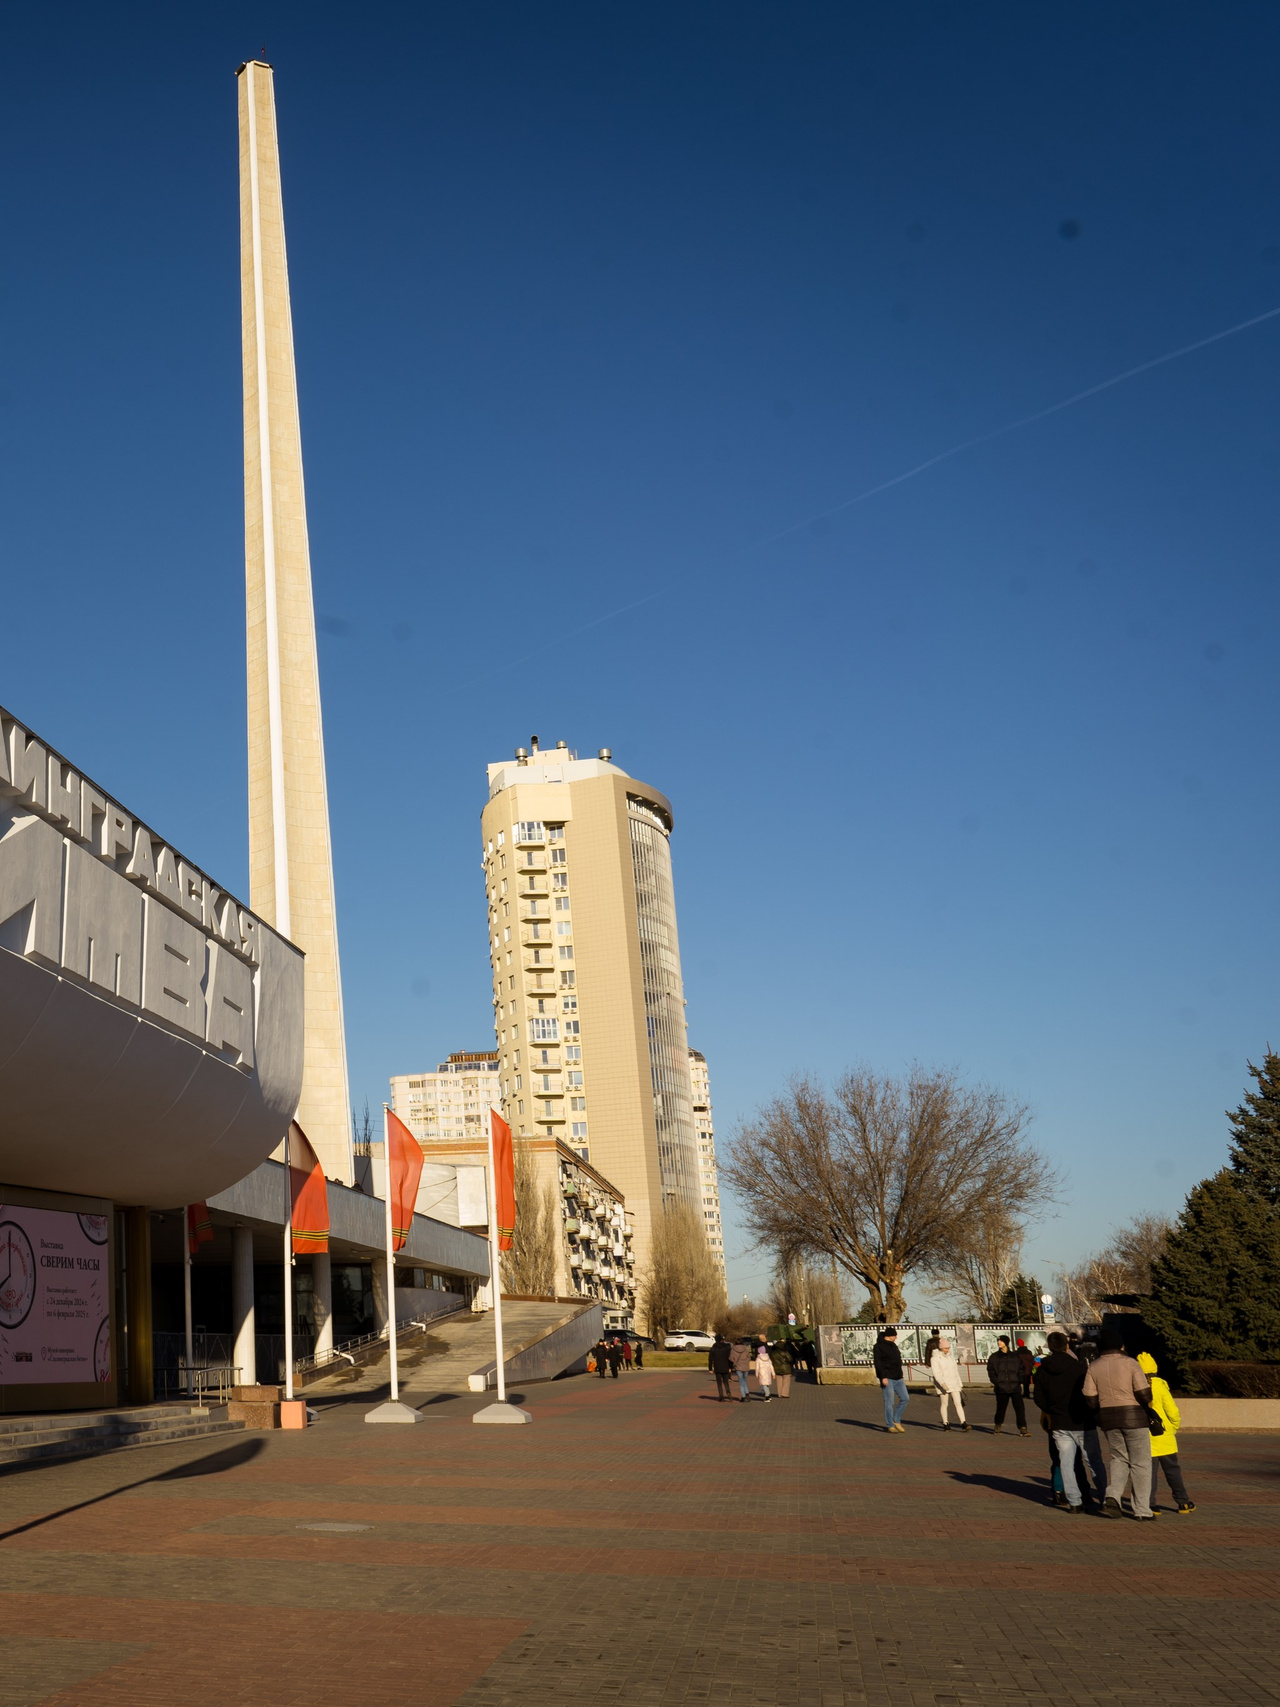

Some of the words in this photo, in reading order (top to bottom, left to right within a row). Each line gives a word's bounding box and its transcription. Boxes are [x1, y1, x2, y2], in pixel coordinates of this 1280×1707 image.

[40, 1238, 64, 1250] Выставка
[40, 1254, 75, 1270] СВЕРИМ
[76, 1257, 101, 1271] ЧАСЫ
